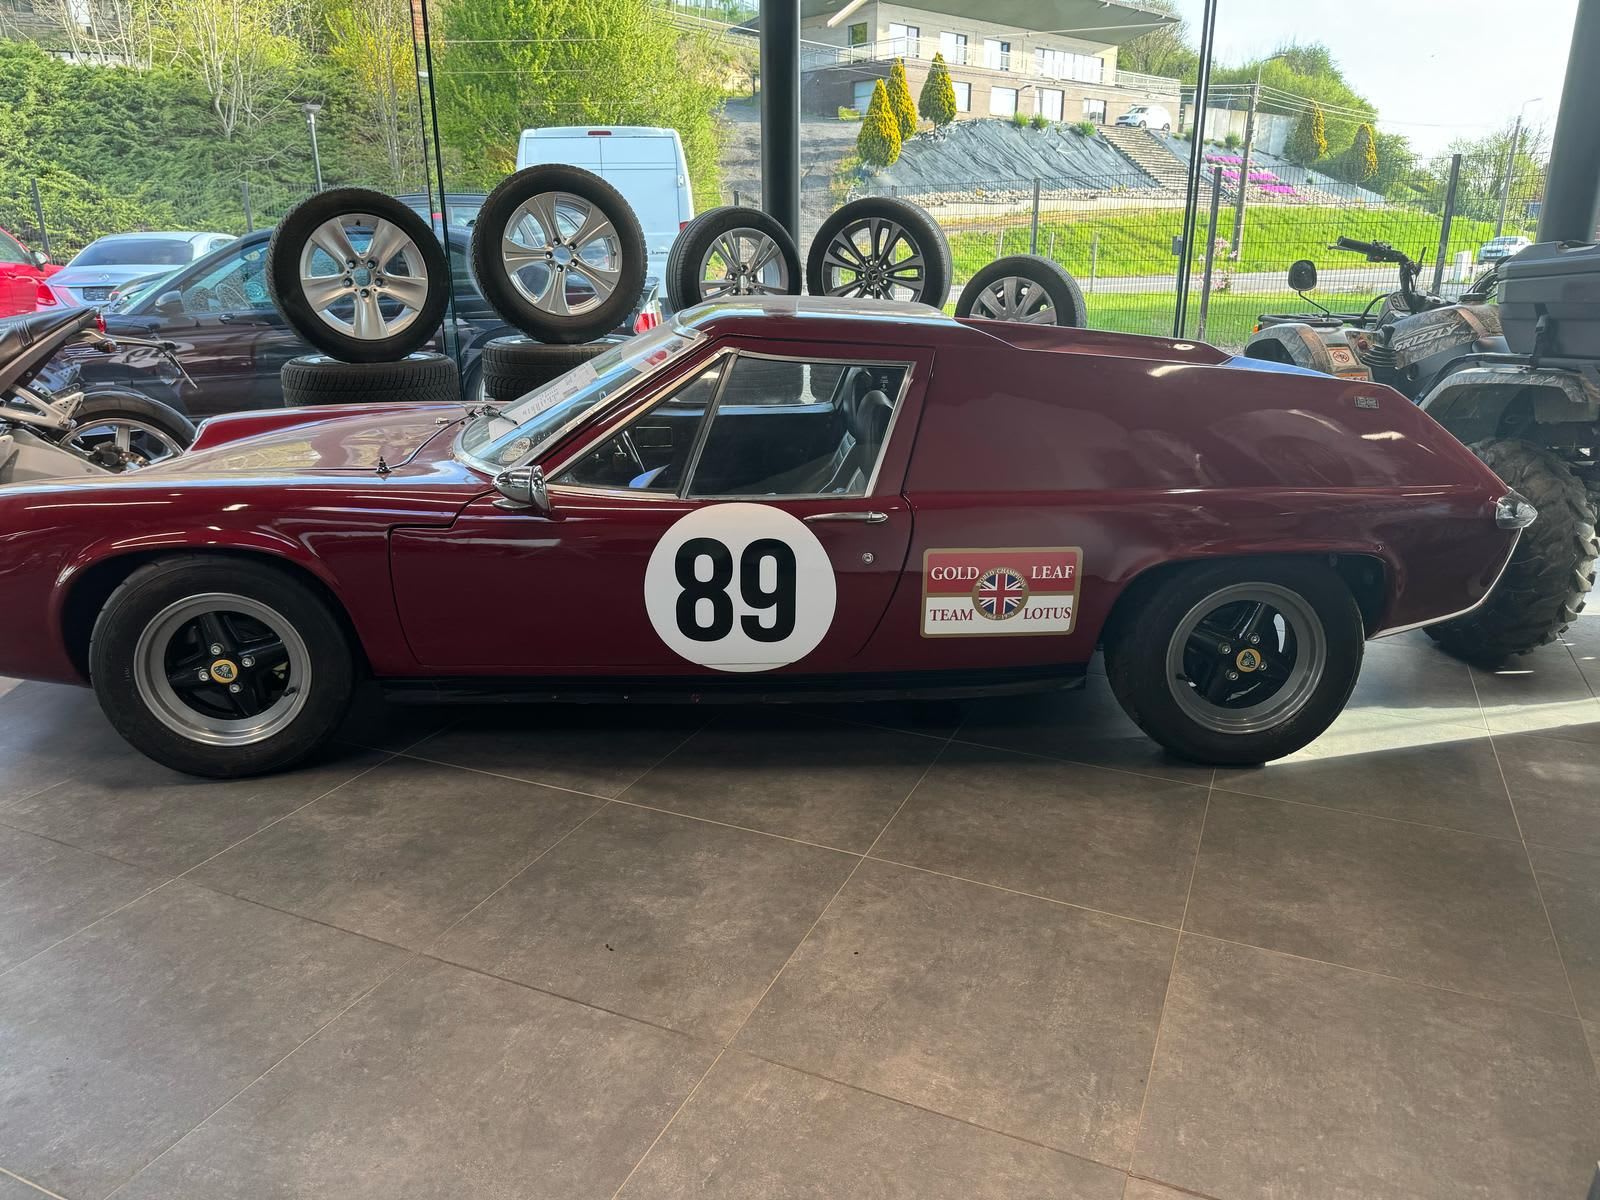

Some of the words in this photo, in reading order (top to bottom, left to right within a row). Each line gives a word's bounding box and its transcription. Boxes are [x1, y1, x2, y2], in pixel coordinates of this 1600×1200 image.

[1394, 324, 1460, 351] GRIZZLY
[930, 566, 980, 581] GOLD
[1031, 565, 1075, 580] LEAF
[674, 537, 797, 642] 89
[929, 608, 974, 621] TEAM
[1023, 607, 1072, 620] LOTUS
